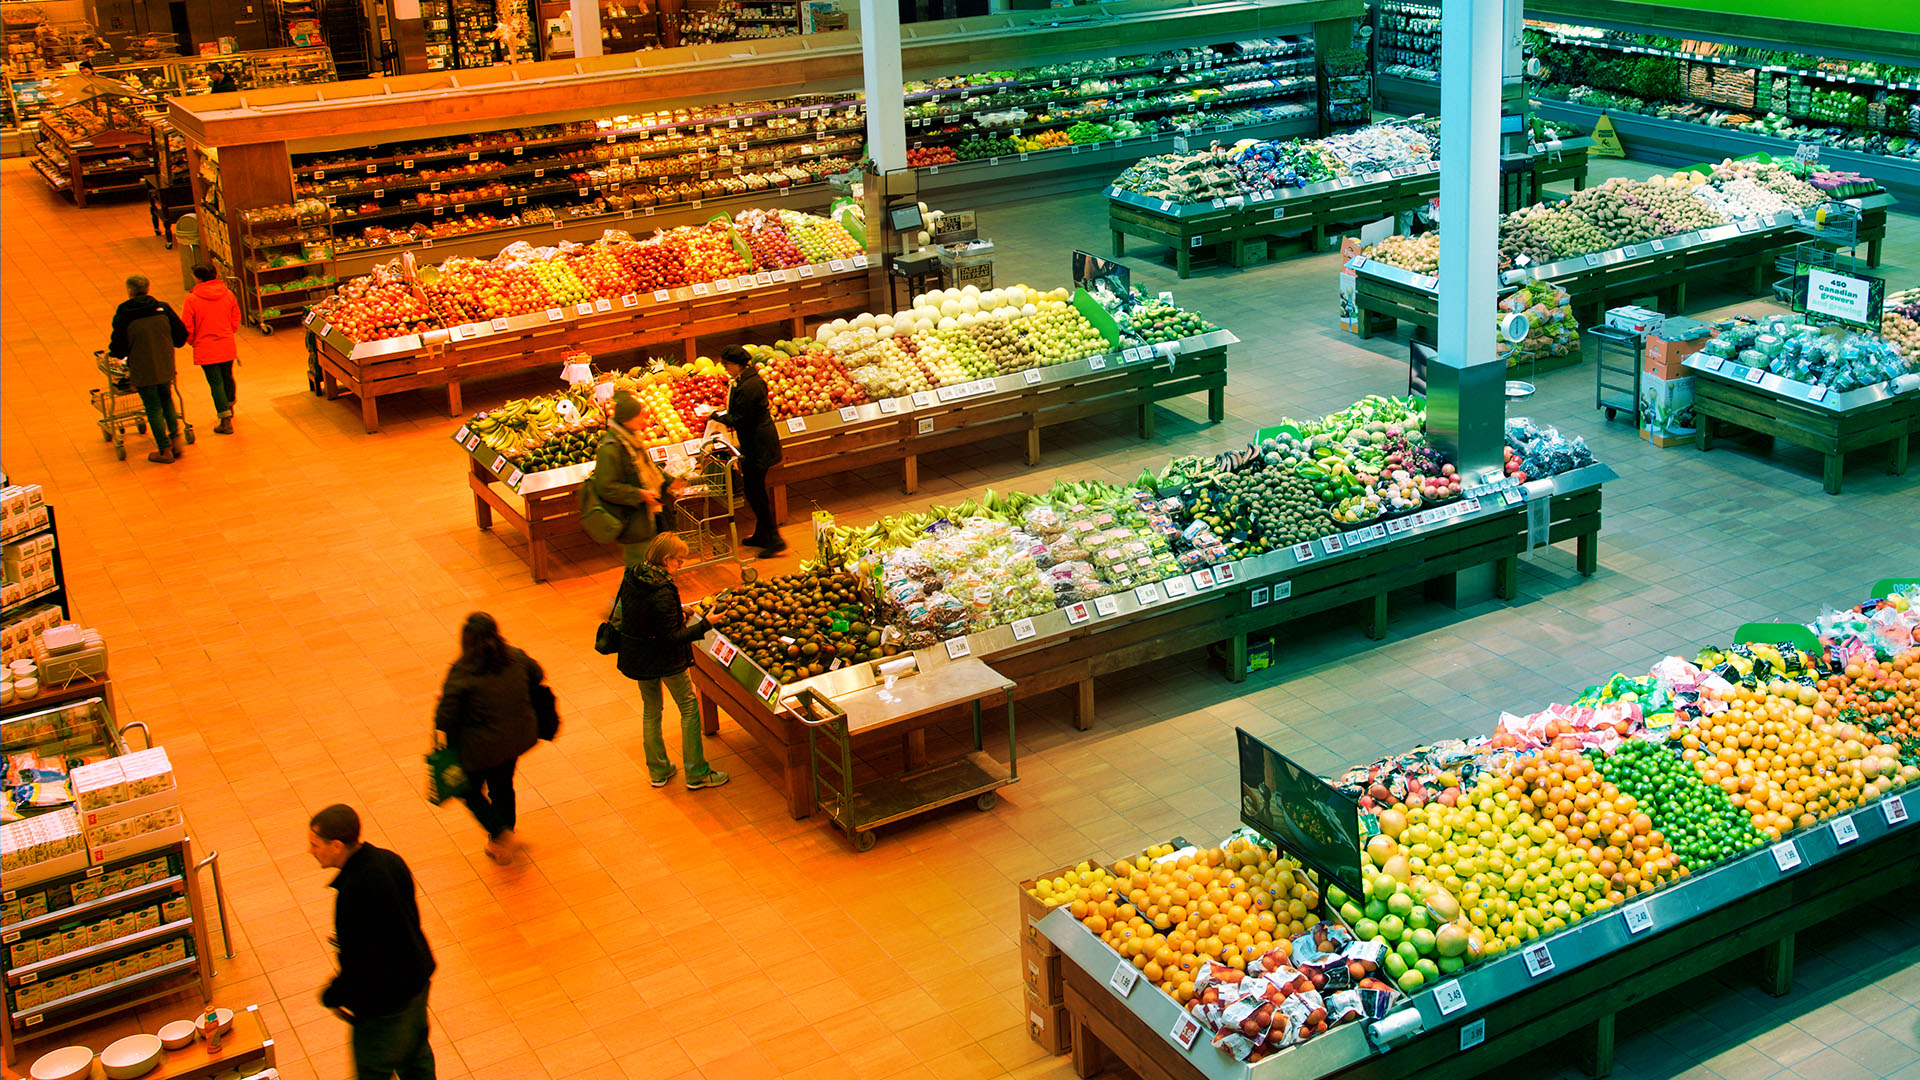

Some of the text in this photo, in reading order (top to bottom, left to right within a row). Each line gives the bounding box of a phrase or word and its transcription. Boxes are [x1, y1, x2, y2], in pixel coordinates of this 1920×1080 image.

[1830, 280, 1847, 288] 450
[1818, 284, 1858, 298] Canadian
[1820, 292, 1855, 305] growers
[1635, 911, 1648, 923] 2.49
[1447, 989, 1461, 1002] 3.49
